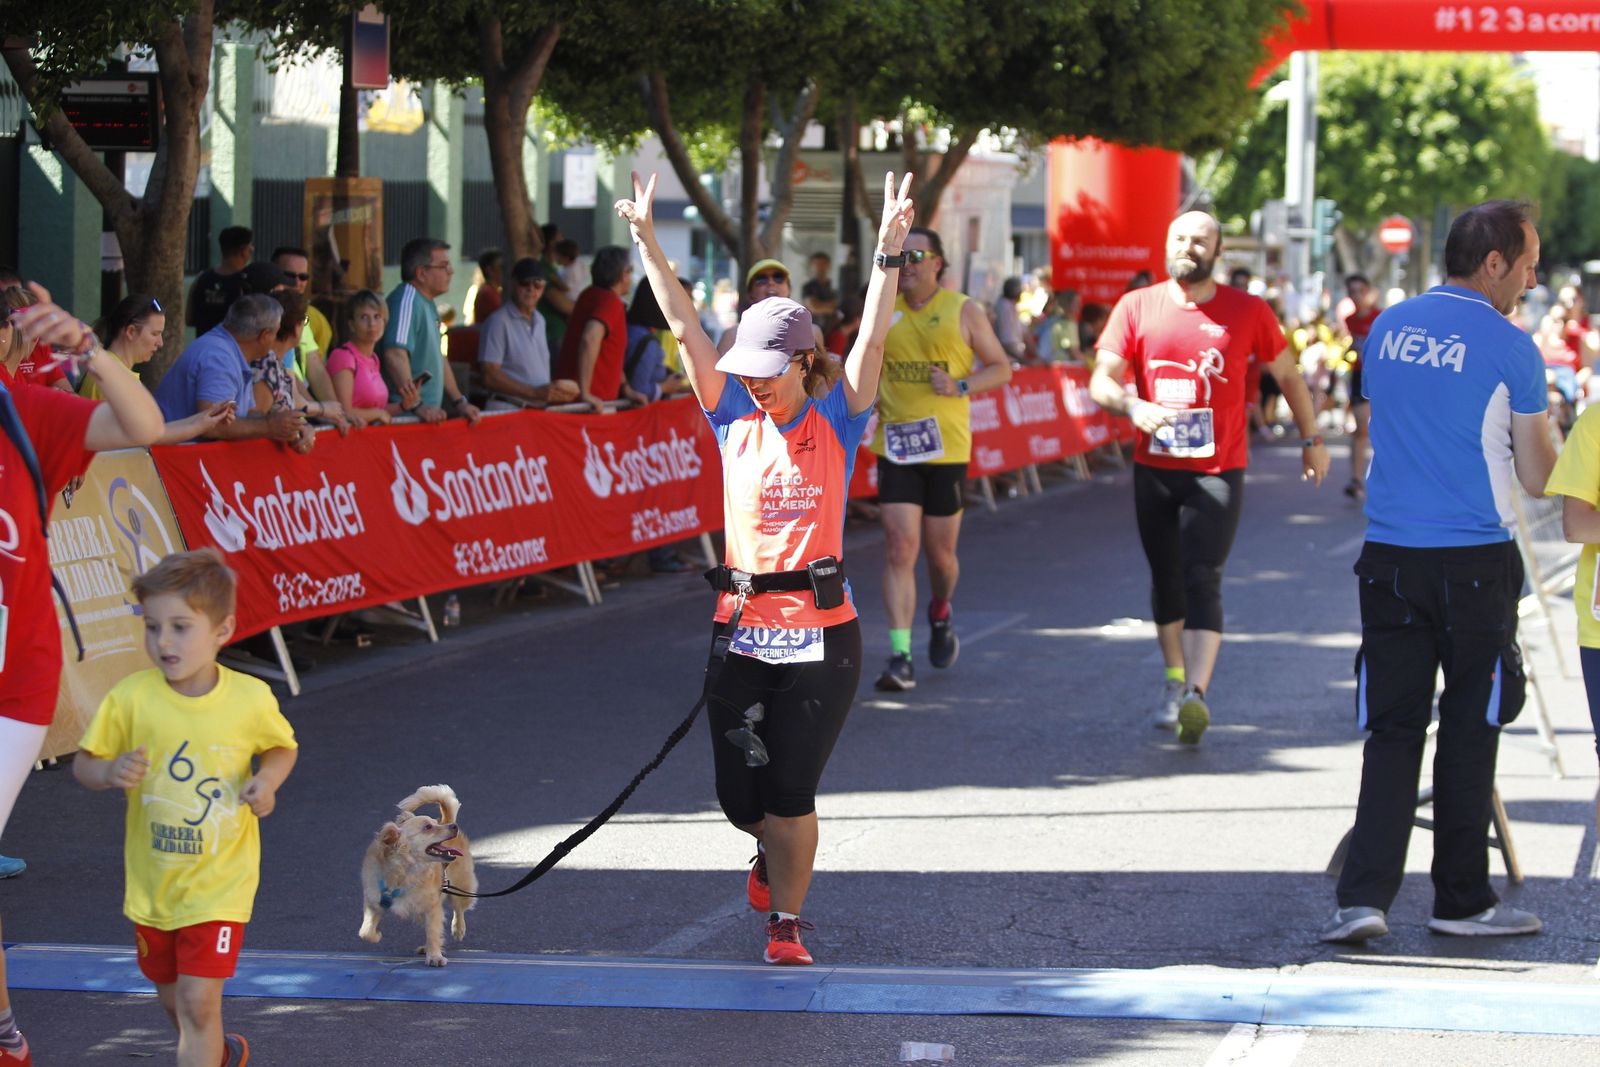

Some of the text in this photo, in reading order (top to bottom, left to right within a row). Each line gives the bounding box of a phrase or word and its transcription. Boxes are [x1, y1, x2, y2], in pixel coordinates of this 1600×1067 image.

[1402, 325, 1427, 335] GRUPO
[891, 431, 931, 450] 2181
[421, 445, 553, 521] Santander
[762, 484, 823, 498] MARATÓN
[233, 471, 365, 551] Santander
[763, 497, 816, 511] ALMERÍA
[737, 626, 806, 646] 2029
[169, 740, 194, 782] 6
[216, 926, 232, 954] 8
